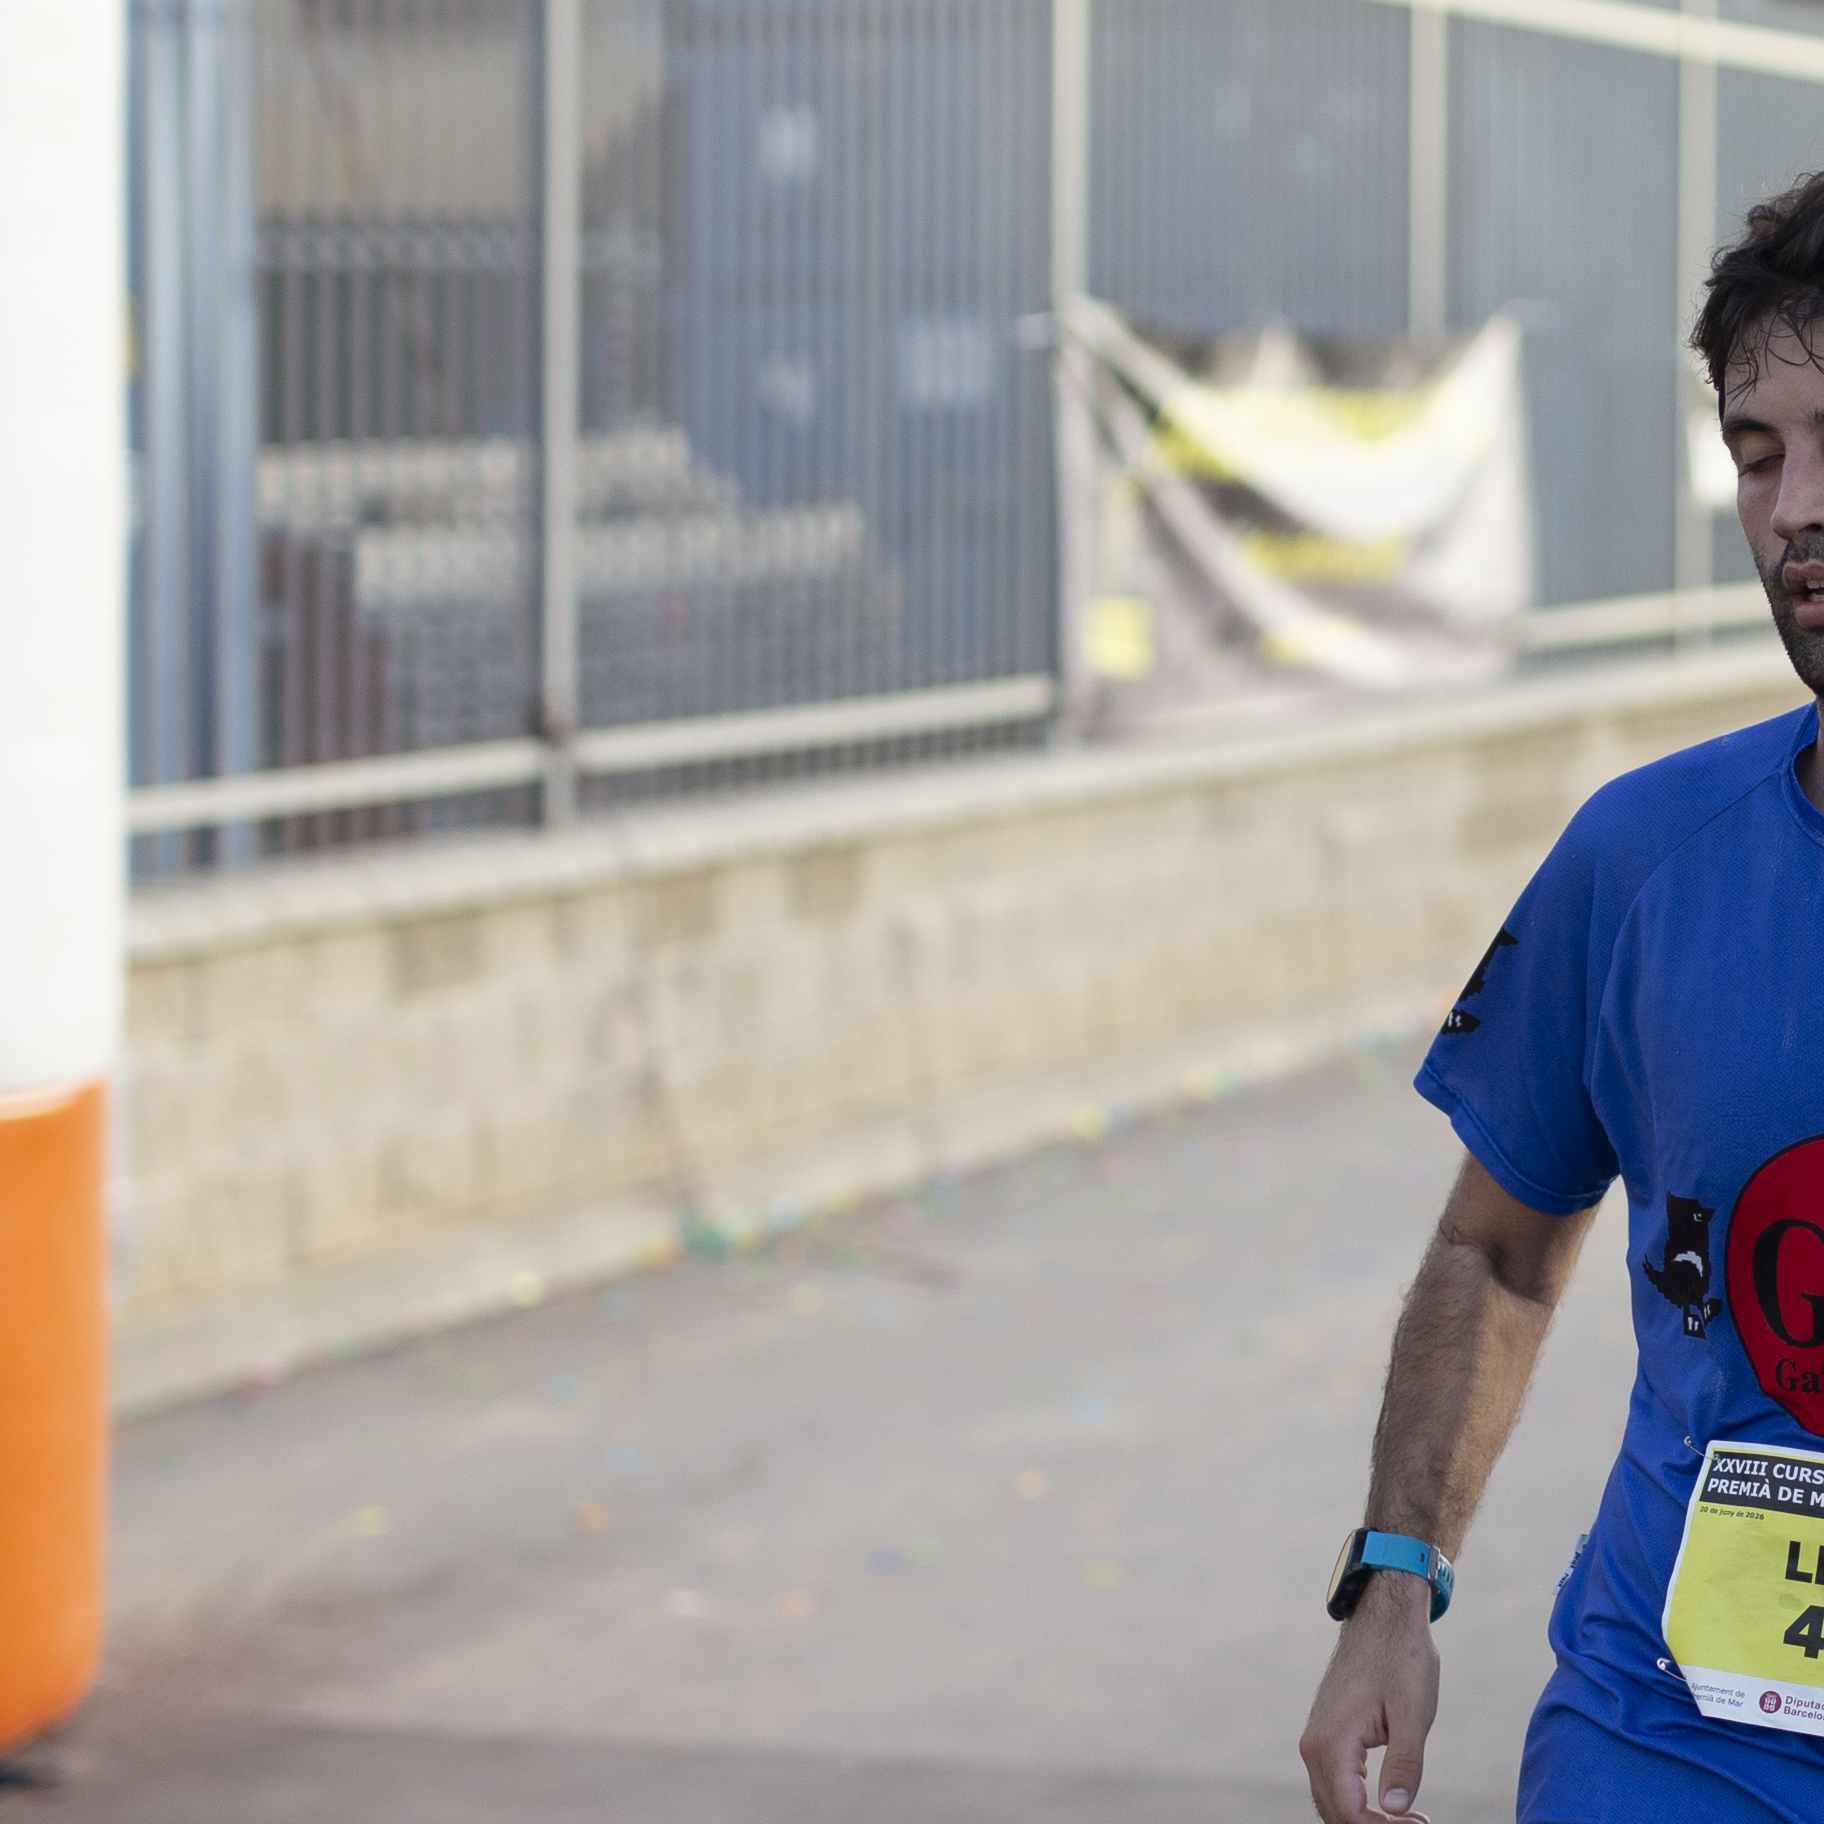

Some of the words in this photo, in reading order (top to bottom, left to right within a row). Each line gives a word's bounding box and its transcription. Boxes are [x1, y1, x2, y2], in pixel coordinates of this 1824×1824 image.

[1713, 1457, 1768, 1476] XXVIII
[1707, 1478, 1771, 1499] PREMIÀ
[1777, 1486, 1804, 1504] DE
[1735, 1690, 1746, 1698] de
[1716, 1696, 1726, 1704] de
[1728, 1698, 1744, 1708] Mar
